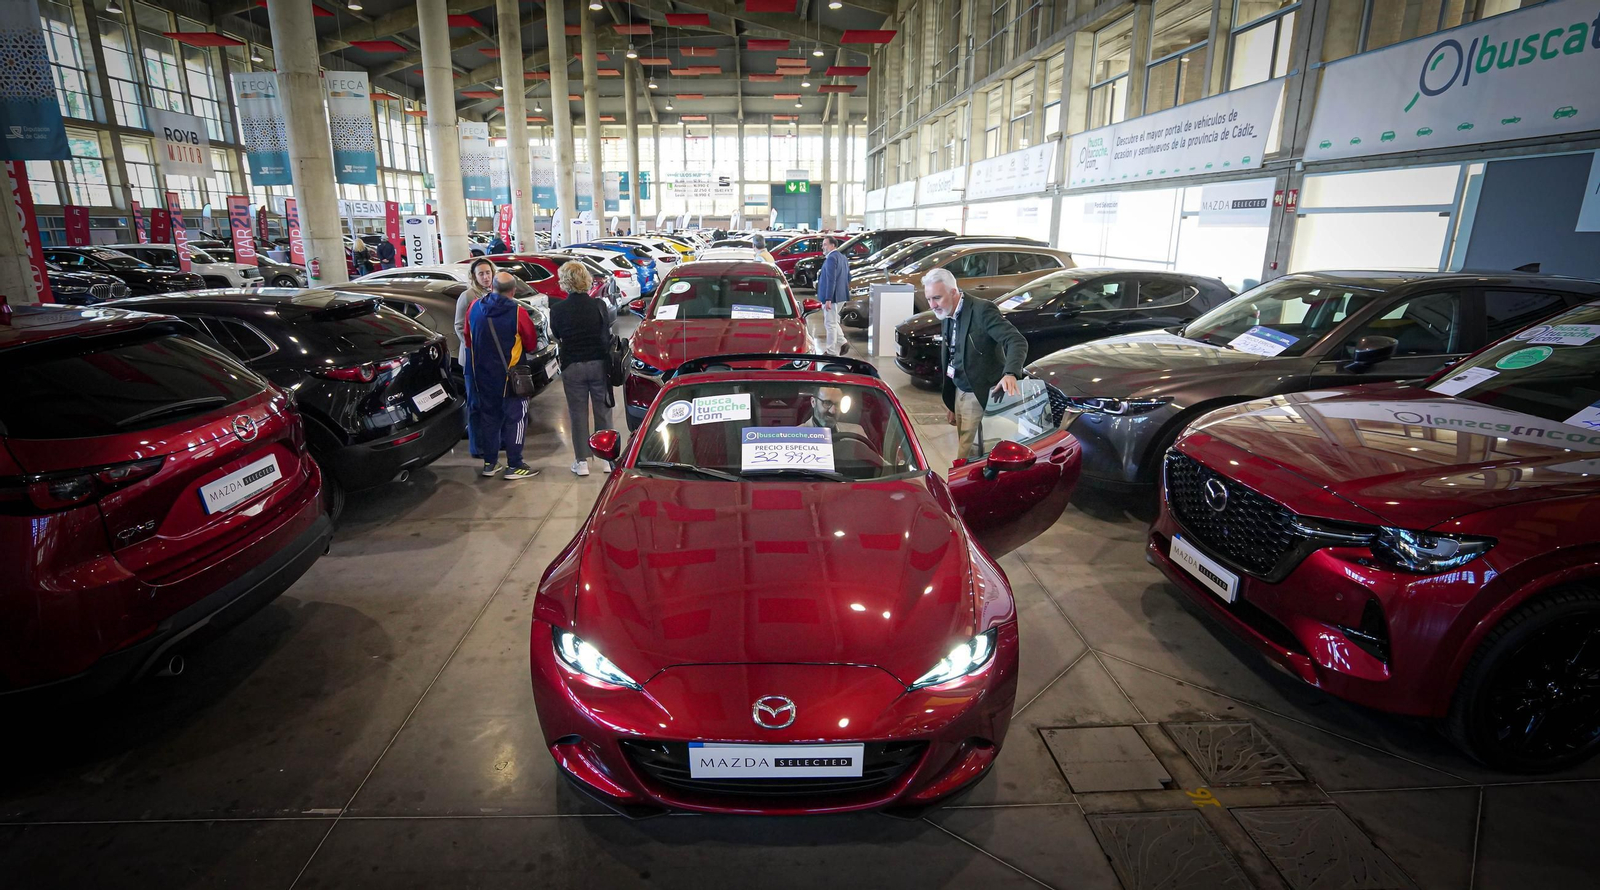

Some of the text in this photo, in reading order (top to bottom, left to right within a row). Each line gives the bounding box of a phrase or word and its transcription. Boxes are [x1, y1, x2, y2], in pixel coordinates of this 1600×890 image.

[237, 80, 274, 91] IFECA
[328, 79, 365, 90] IFECA
[461, 127, 486, 135] IFECA
[1116, 109, 1238, 147] Descubre el mayor portal de vehículos de
[164, 127, 200, 145] ROYB
[1114, 148, 1133, 161] ocasión
[1133, 150, 1137, 160] y
[1138, 141, 1170, 157] seminuevos
[1171, 139, 1179, 150] de
[1180, 138, 1186, 148] la
[1187, 130, 1218, 149] provincia
[1220, 128, 1229, 140] de
[167, 144, 202, 164] MOTOR
[345, 202, 382, 213] NISSAN
[1202, 199, 1267, 211] MAZDA SELECTED
[500, 204, 510, 243] NISSA
[697, 397, 732, 407] busca
[697, 402, 750, 414] tucoche.
[751, 451, 779, 463] 32
[209, 480, 243, 503] MAZDA
[244, 465, 274, 484] SELECTED
[116, 519, 156, 540] CX-5
[1173, 545, 1227, 590] MAZDA SELECTED
[700, 758, 849, 768] MAZDA SELECTED
